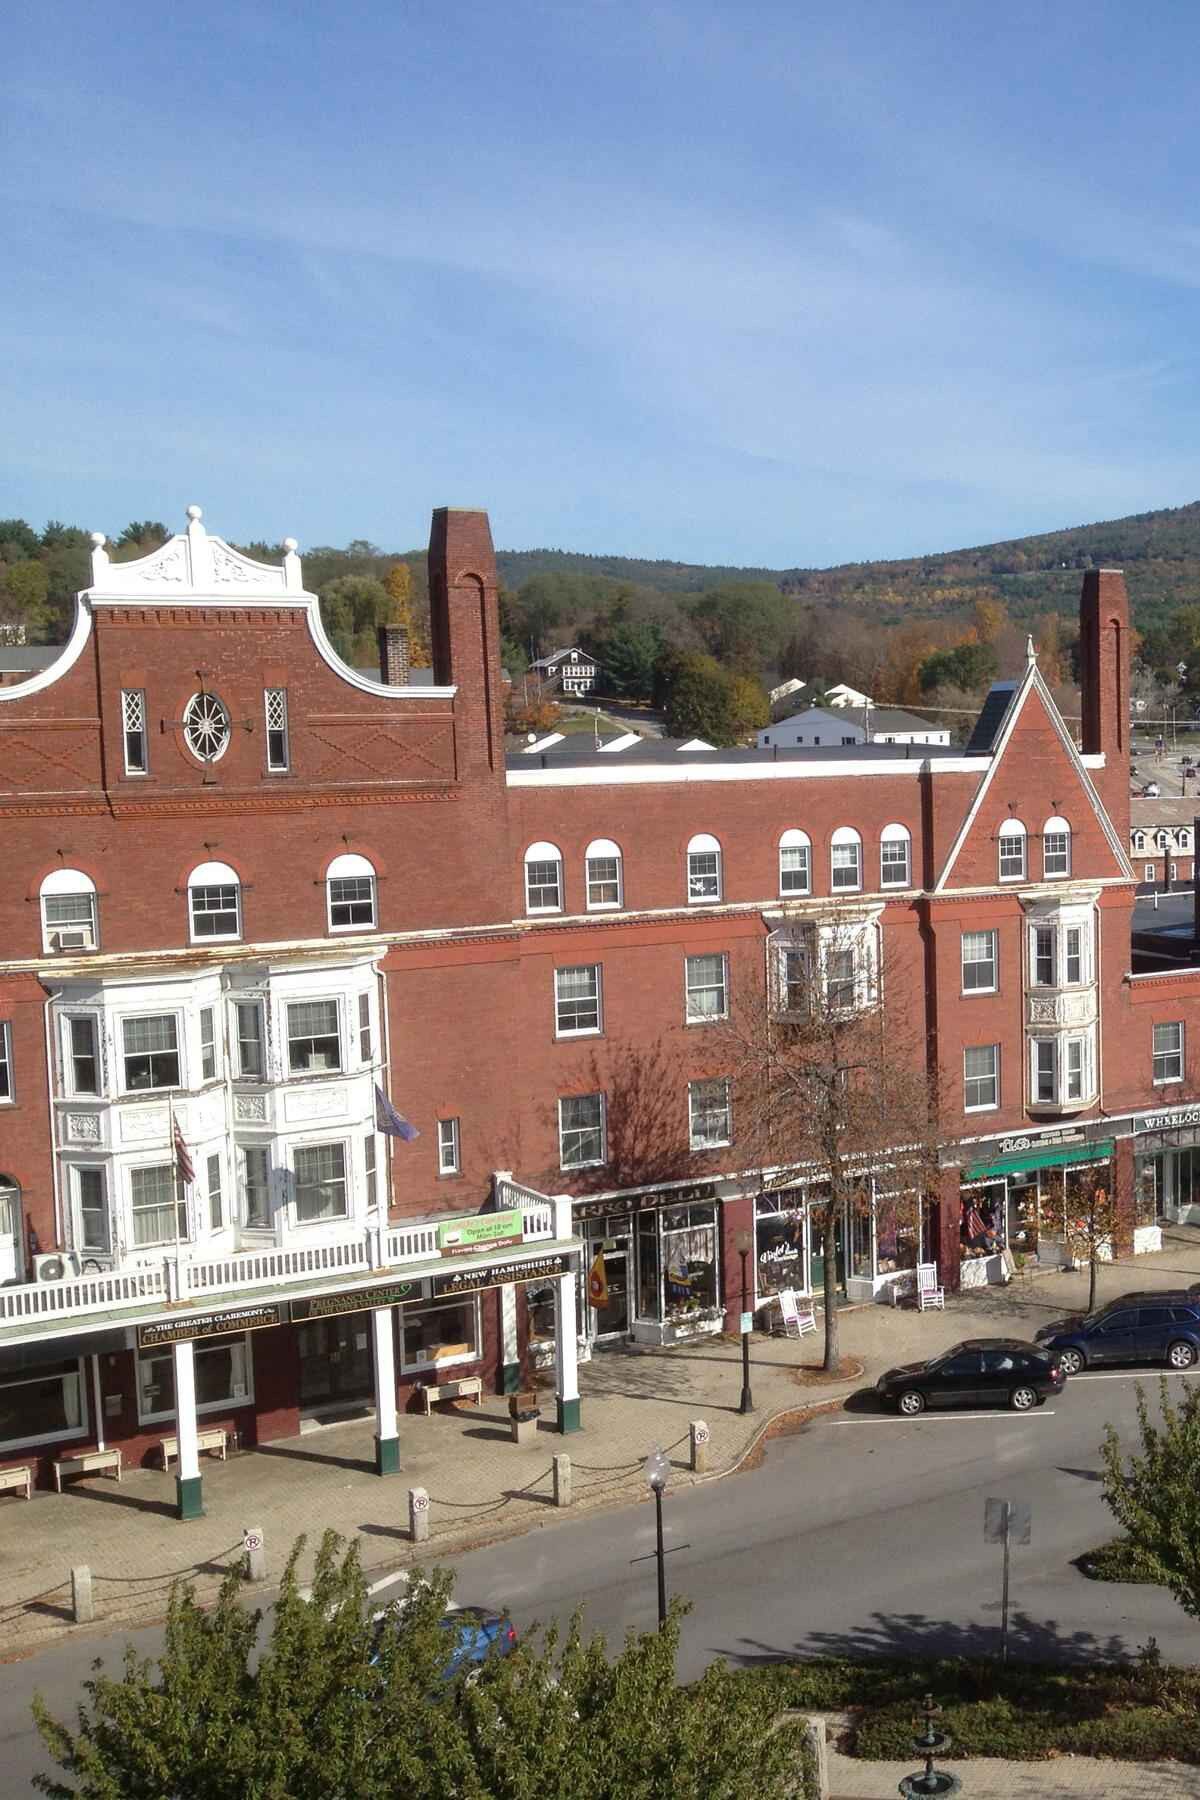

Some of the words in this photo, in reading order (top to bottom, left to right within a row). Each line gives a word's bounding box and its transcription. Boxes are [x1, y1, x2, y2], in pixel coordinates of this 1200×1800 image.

[443, 1278, 484, 1293] LEGAL
[488, 1264, 562, 1285] ASSISTANCE
[463, 1270, 488, 1280] NEW
[491, 1259, 553, 1276] HAMPSHIRE
[310, 1292, 365, 1309] PREGNANCY
[366, 1286, 400, 1299] CENTER
[142, 1326, 199, 1345] CHAMBER
[202, 1325, 215, 1334] of
[216, 1314, 278, 1331] COMMERCE
[156, 1323, 174, 1332] THE
[174, 1316, 213, 1329] GREATER
[214, 1308, 265, 1322] CLAREMONT
